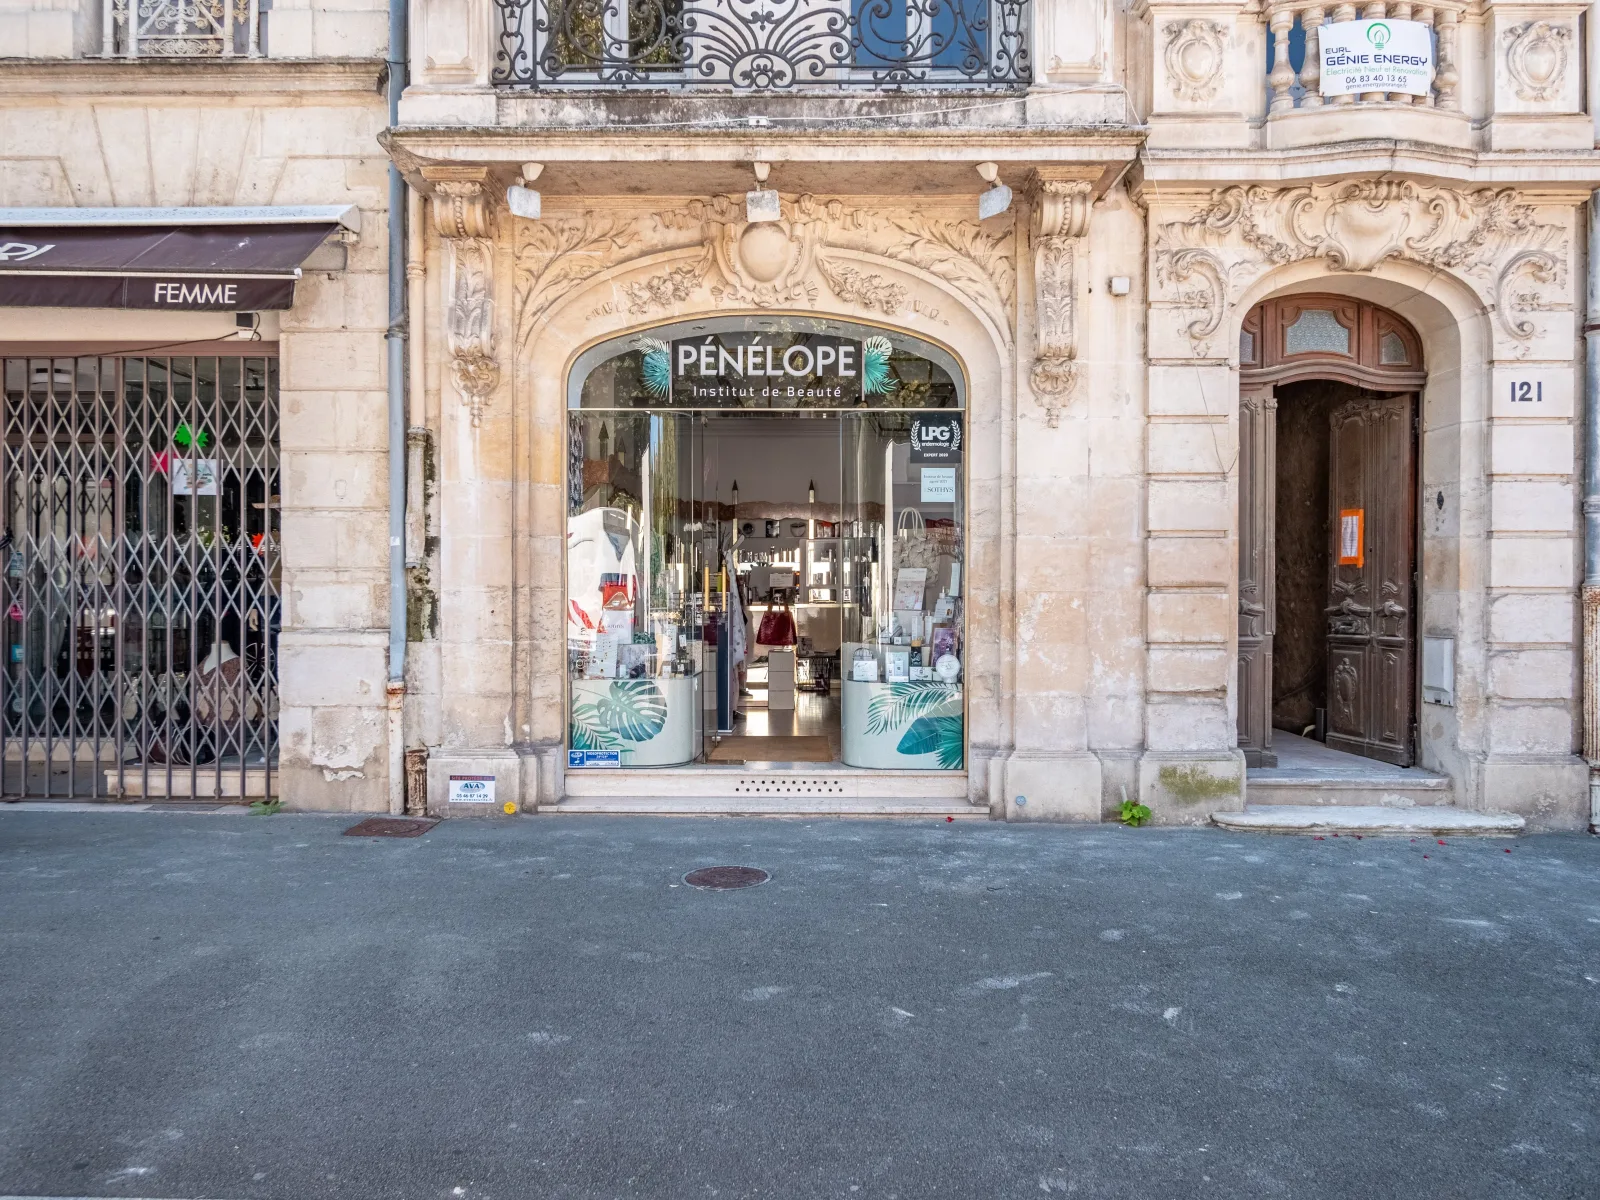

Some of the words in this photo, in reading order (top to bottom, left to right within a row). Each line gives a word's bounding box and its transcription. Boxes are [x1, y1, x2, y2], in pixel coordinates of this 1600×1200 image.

[1326, 53, 1369, 66] GÉNIE
[1374, 54, 1428, 66] ENERGY
[1364, 65, 1382, 73] Neuf
[1397, 75, 1407, 83] 65
[154, 283, 237, 304] FEMME
[678, 336, 857, 378] PÉNÉLOPE
[693, 386, 757, 397] Institut
[762, 386, 779, 397] de
[787, 386, 841, 397] Beauté
[1510, 381, 1542, 402] 121
[921, 426, 951, 441] LPG
